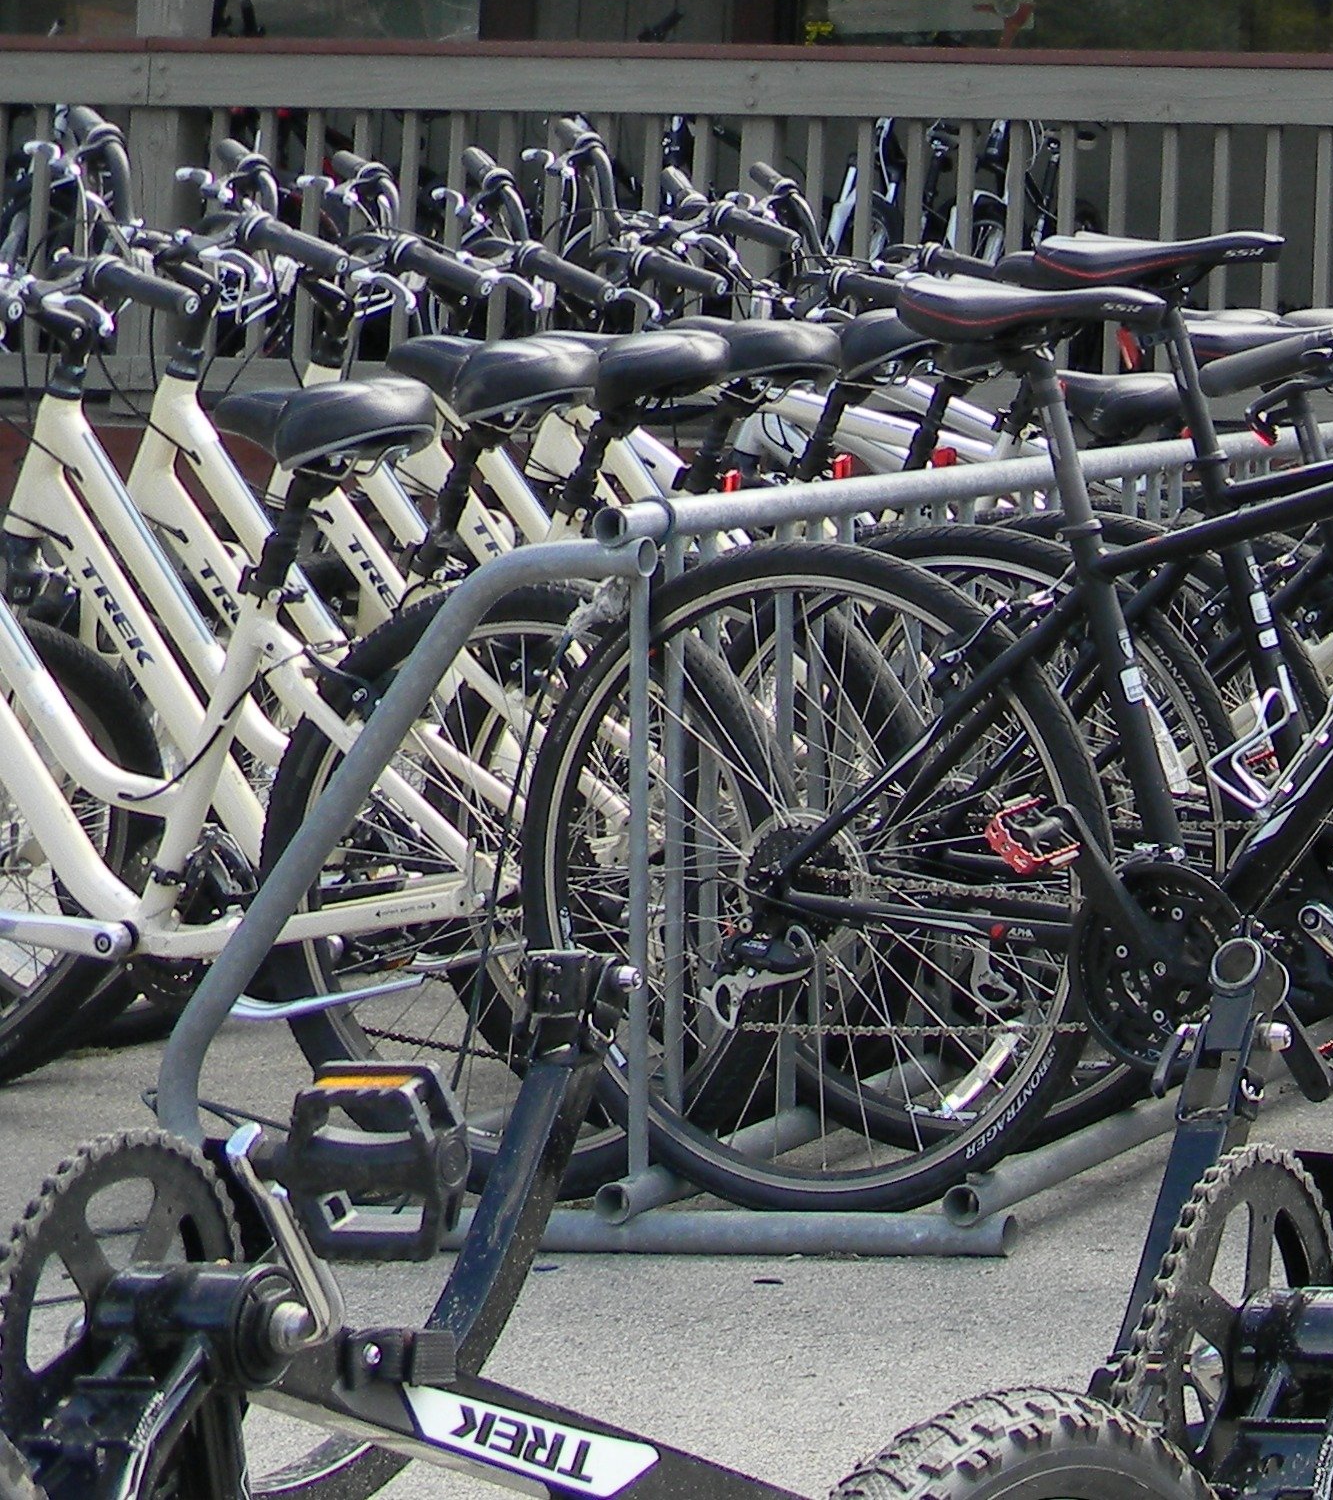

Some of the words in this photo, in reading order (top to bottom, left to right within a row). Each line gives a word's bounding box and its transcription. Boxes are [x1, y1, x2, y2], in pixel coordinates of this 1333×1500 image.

[81, 556, 155, 668] TREK
[348, 533, 400, 612] TRE
[449, 1403, 596, 1485] TREK
